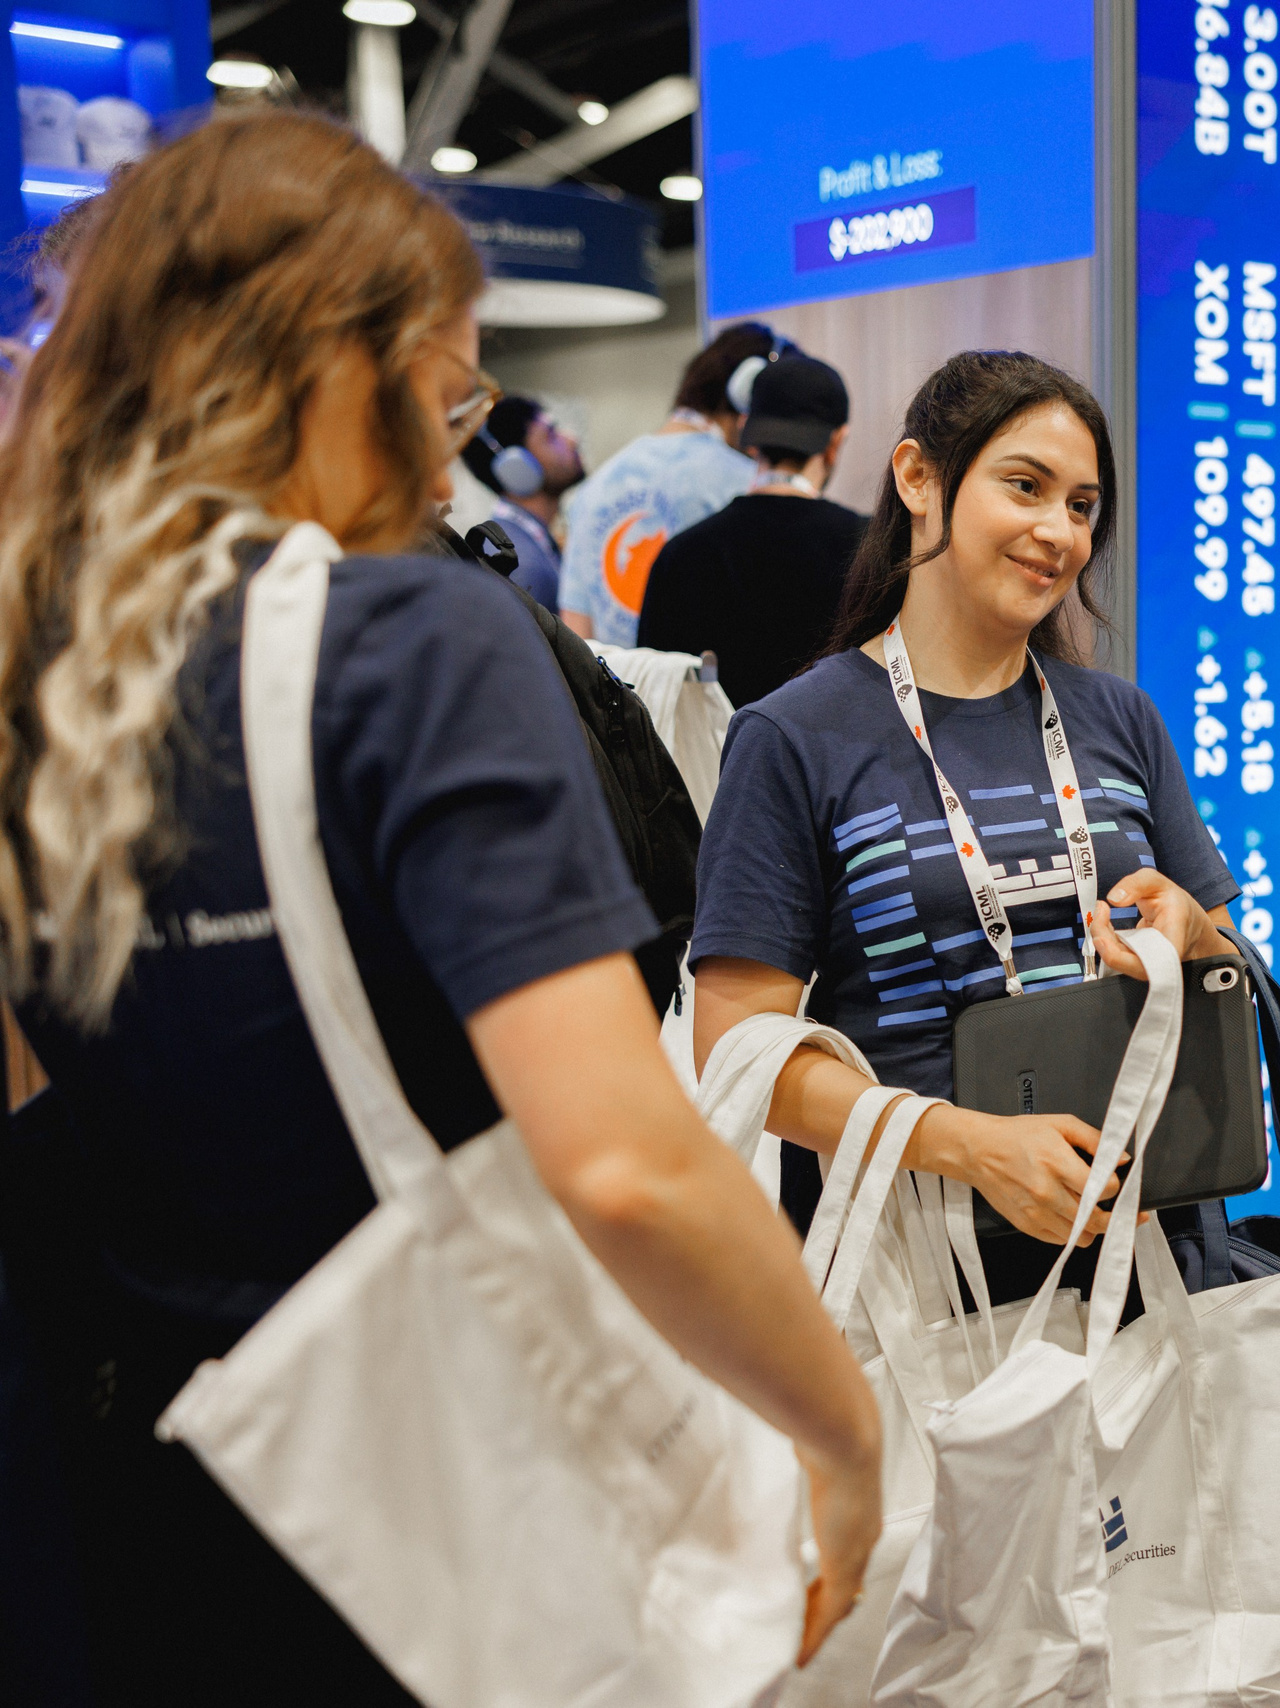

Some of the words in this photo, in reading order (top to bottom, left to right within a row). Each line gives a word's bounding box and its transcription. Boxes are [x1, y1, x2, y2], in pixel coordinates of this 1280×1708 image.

[1194, 0, 1230, 156] 6.84B
[1243, 4, 1278, 165] 3.00T
[818, 160, 872, 203] Profit
[872, 154, 890, 191] &
[1194, 260, 1229, 385] XOM
[1243, 260, 1277, 407] MSFT
[1194, 436, 1229, 601] 109.99
[1242, 453, 1276, 617] 497.45
[890, 656, 904, 685] ICML
[1193, 654, 1228, 778] +1.62
[1052, 728, 1066, 759] ICML
[1241, 671, 1274, 795] +5.18
[976, 885, 994, 922] ICML
[1080, 847, 1093, 880] ICML
[1023, 1078, 1033, 1114] OTTER
